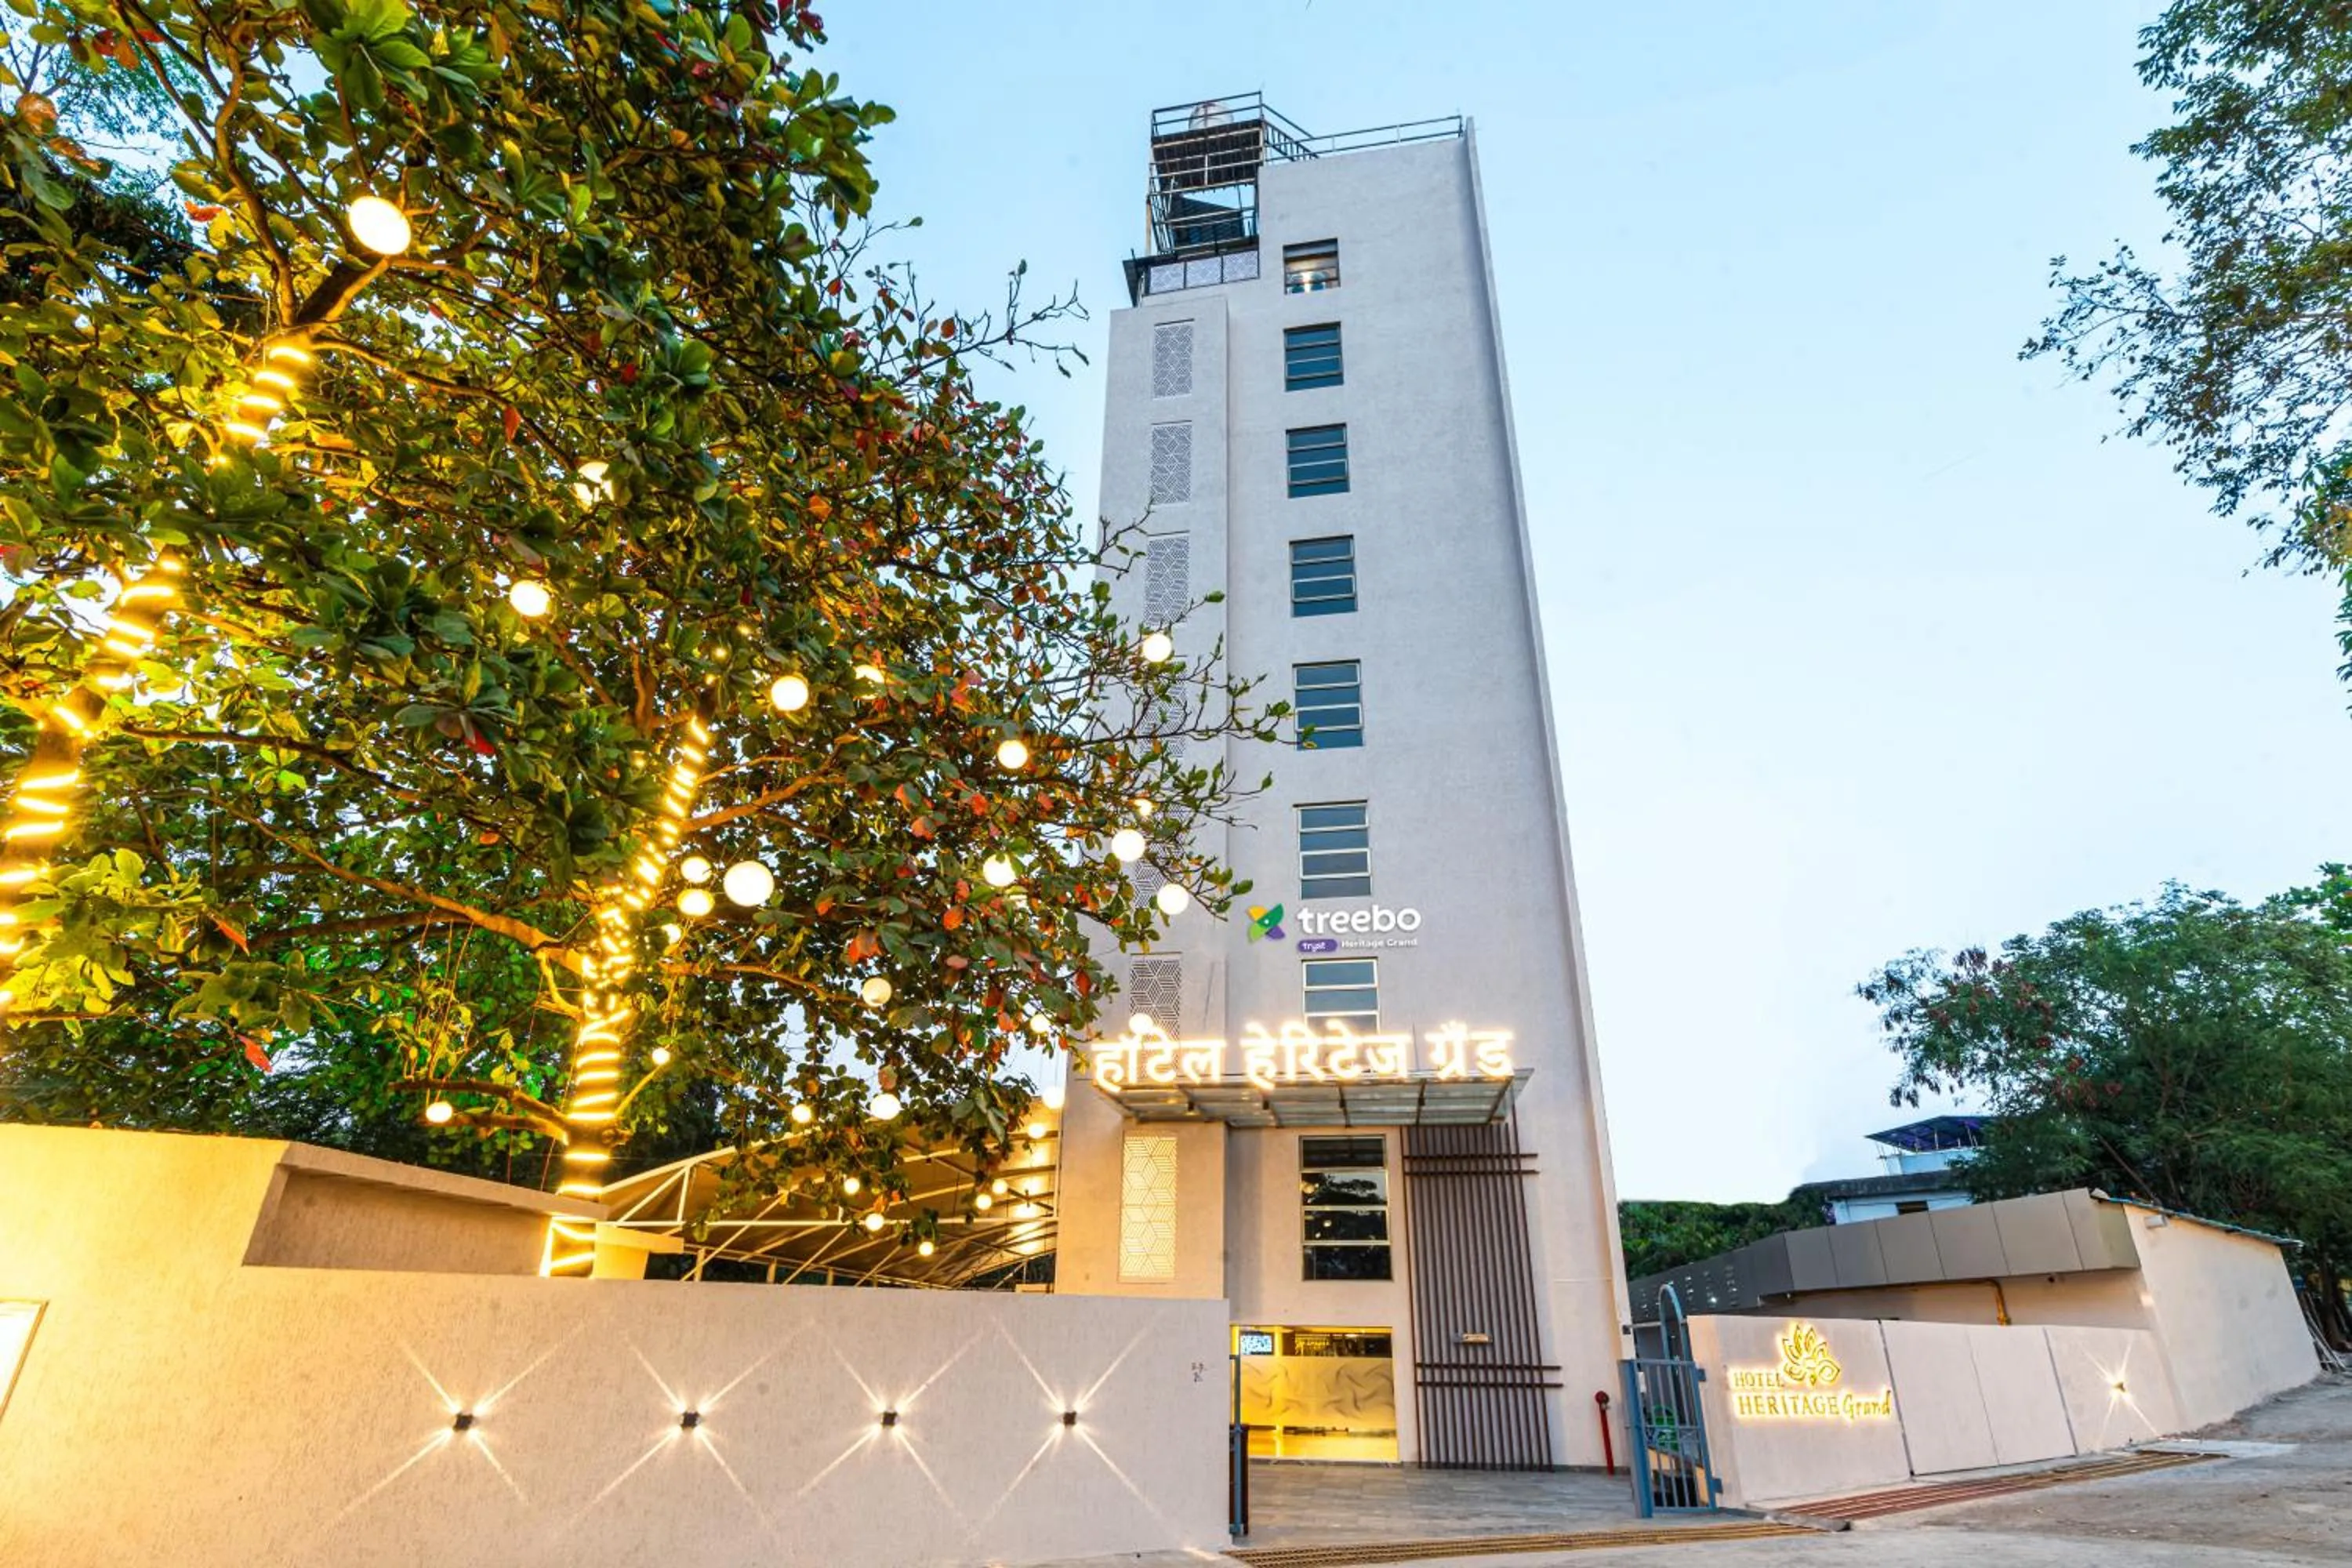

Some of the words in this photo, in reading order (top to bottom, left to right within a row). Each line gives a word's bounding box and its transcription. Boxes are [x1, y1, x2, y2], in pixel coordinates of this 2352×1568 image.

[1297, 905, 1421, 934] treebo
[1341, 939, 1385, 949] Heritage
[1387, 938, 1417, 947] Grand
[1240, 1020, 1410, 1090] हेरिटेज
[1733, 1372, 1785, 1387] HOTEL
[1738, 1395, 1840, 1416] HERITAGE
[1843, 1390, 1892, 1418] Grand
